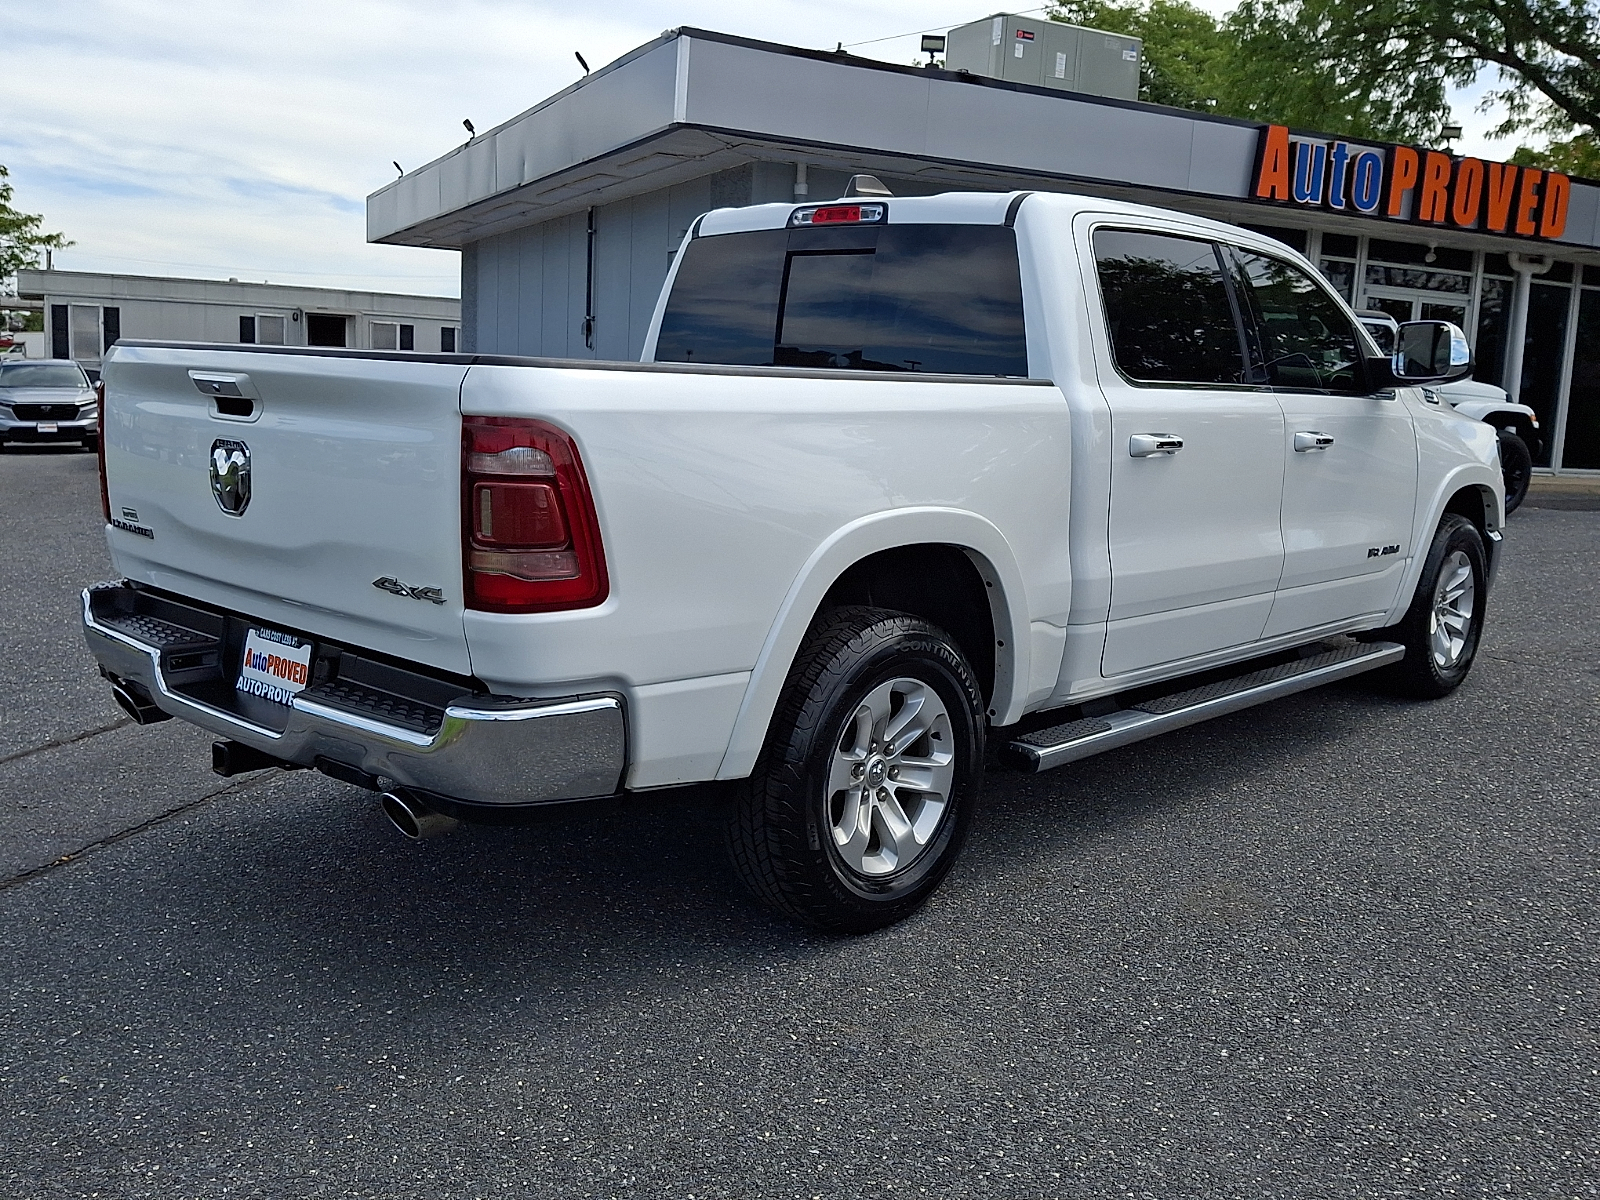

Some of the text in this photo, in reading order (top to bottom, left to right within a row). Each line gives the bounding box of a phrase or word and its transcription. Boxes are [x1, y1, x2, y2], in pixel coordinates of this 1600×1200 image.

[1257, 124, 1570, 238] AutoPROVED
[1367, 544, 1400, 558] RAM
[260, 627, 271, 639] CARS
[271, 630, 282, 642] COST
[281, 633, 292, 645] LESS
[245, 648, 307, 685] AutoPROVED
[236, 676, 295, 706] AUTOPROVE
